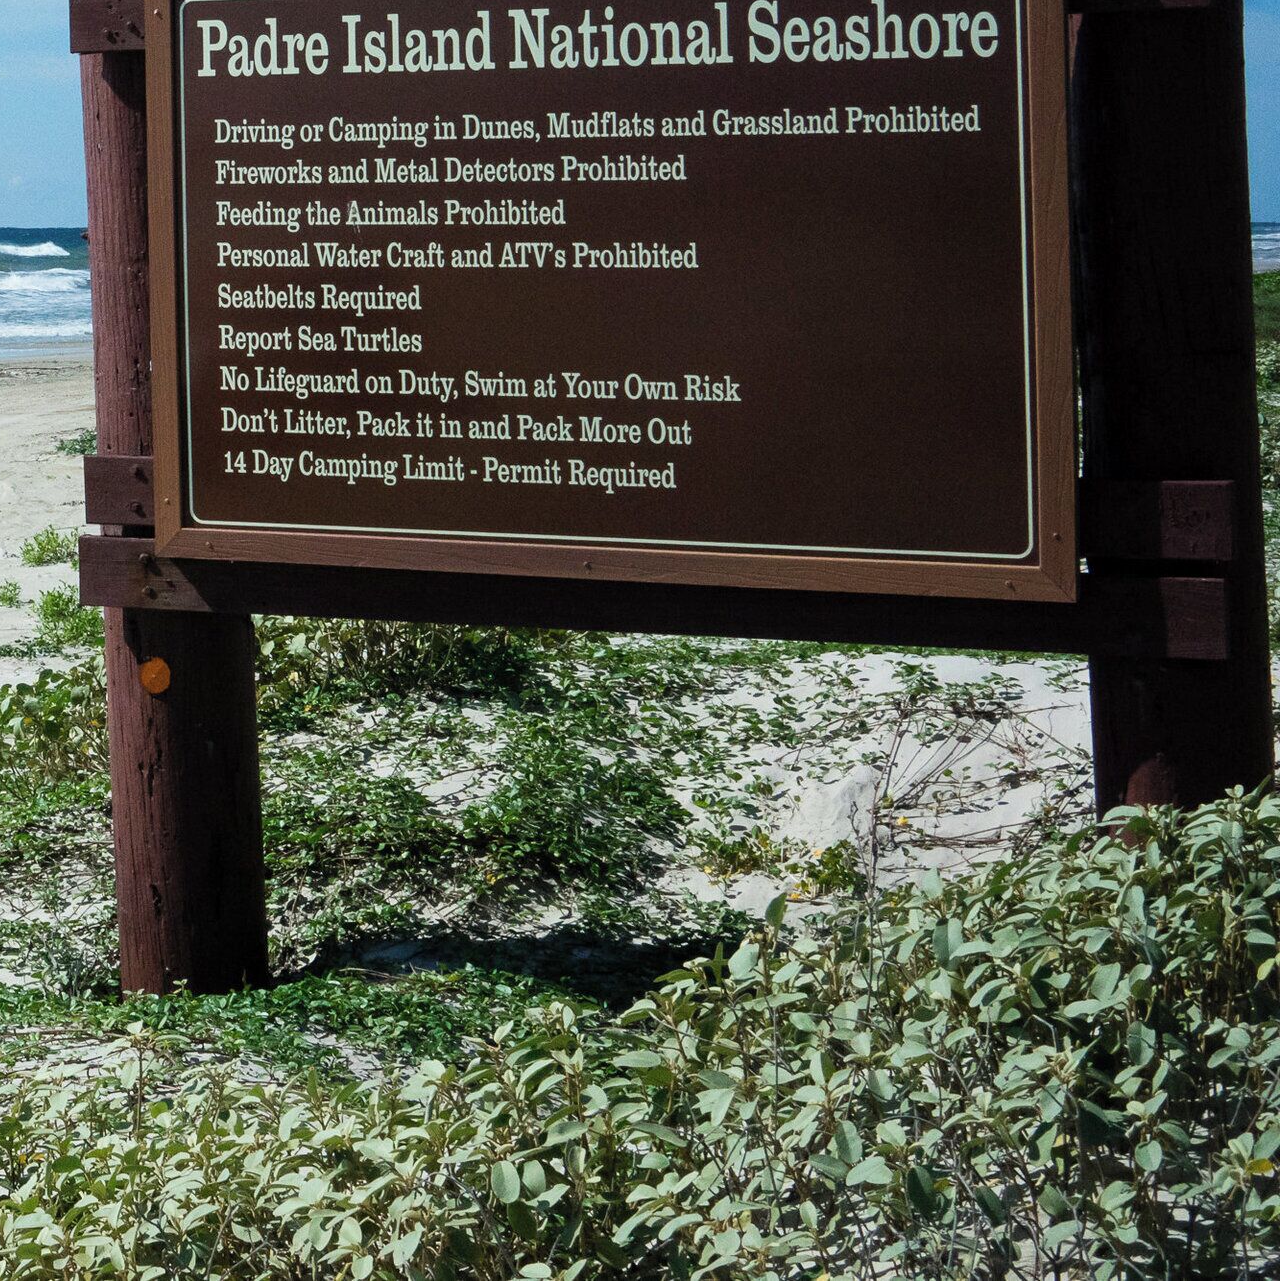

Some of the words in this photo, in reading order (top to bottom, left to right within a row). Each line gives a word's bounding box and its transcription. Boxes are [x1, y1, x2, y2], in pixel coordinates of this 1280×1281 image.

[197, 18, 329, 77] Padre
[342, 11, 495, 73] Island
[508, 2, 733, 68] National
[214, 118, 295, 149] Driving
[300, 124, 324, 142] or
[329, 116, 428, 148] Camping
[434, 115, 457, 140] in
[462, 115, 540, 142] Dunes,
[547, 112, 654, 138] Mudflats
[662, 110, 706, 136] and
[713, 108, 839, 135] Grassland
[845, 105, 981, 133] Prohibited
[215, 159, 322, 184] Fireworks
[328, 159, 369, 183] and
[374, 158, 439, 183] Metal
[444, 157, 554, 182] Detectors
[561, 155, 687, 181] Prohibited
[216, 201, 301, 232] Feeding
[306, 201, 340, 225] the
[346, 200, 438, 225] Animals
[444, 199, 566, 225] Prohibited
[217, 242, 310, 267] Personal
[314, 243, 382, 267] Water
[387, 242, 444, 267] Craft
[451, 243, 494, 268] and
[499, 242, 566, 268] ATV's
[572, 242, 699, 268] Prohibited
[218, 283, 315, 309] Seatbelts
[321, 284, 422, 316] Required
[219, 325, 292, 357] Report
[298, 326, 337, 351] Sea
[341, 326, 422, 352] Turtles
[220, 366, 249, 391] No
[255, 367, 360, 399] Lifeguard
[366, 376, 393, 394] on
[399, 370, 458, 402] Duty,
[465, 370, 528, 396] Swim
[534, 374, 556, 398] at
[562, 373, 618, 398] Your
[625, 374, 678, 400] Own
[684, 375, 741, 401] Risk
[221, 407, 278, 433] Don't
[284, 409, 351, 439] Litter,
[357, 411, 411, 436] Pack
[416, 412, 433, 437] it
[440, 413, 463, 438] in
[469, 415, 511, 439] and
[517, 415, 574, 441] Pack
[579, 417, 641, 443] More
[648, 418, 691, 445] Out
[225, 451, 246, 473] 14
[252, 450, 294, 482] Day
[299, 451, 398, 485] Camping
[403, 454, 464, 481] Limit
[483, 457, 561, 484] Permit
[568, 460, 676, 494] Required
